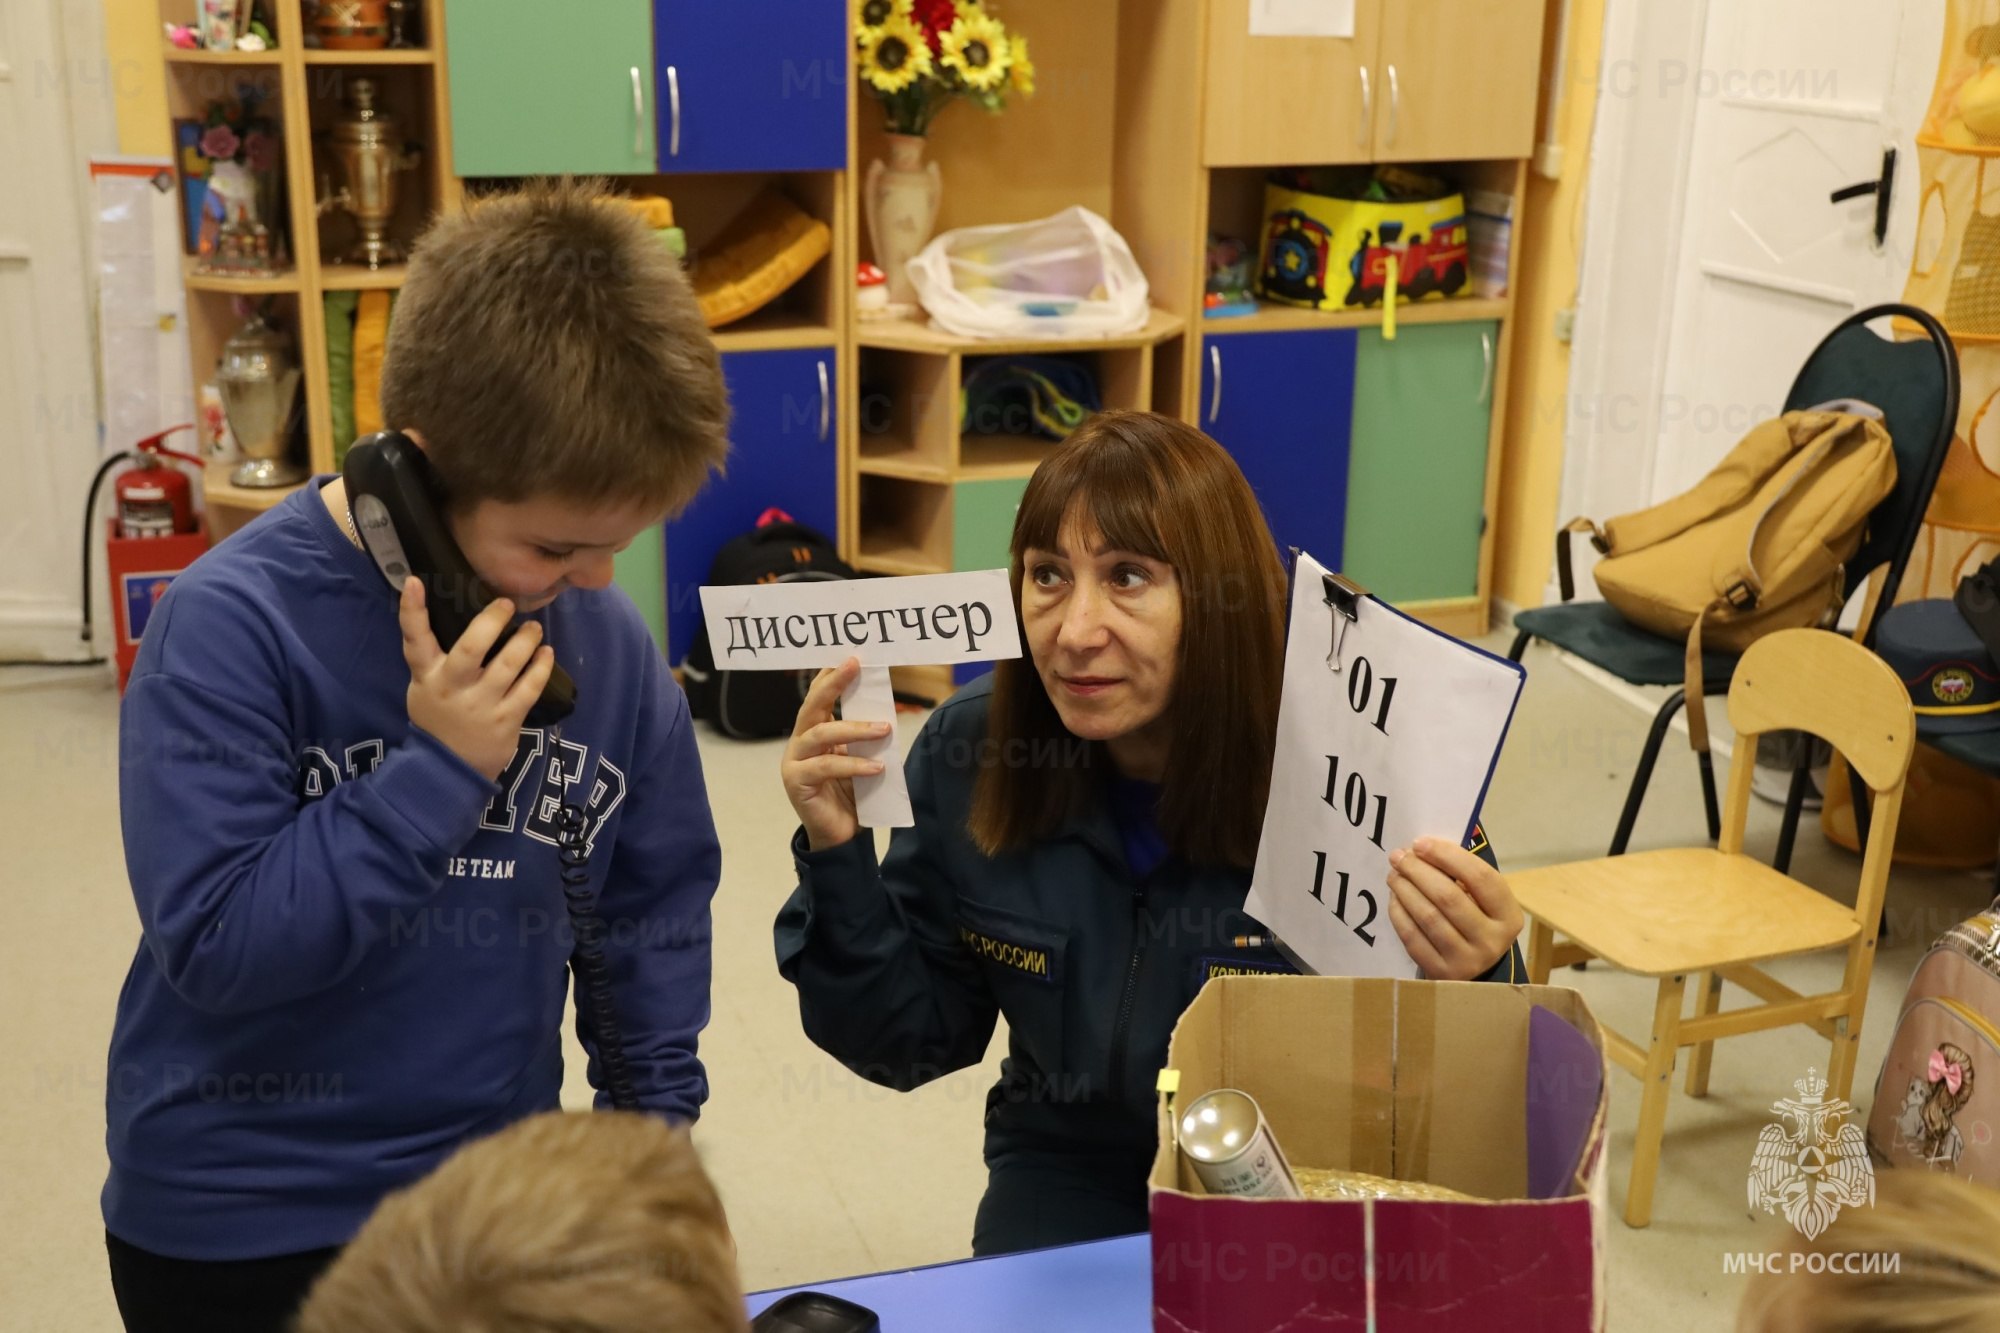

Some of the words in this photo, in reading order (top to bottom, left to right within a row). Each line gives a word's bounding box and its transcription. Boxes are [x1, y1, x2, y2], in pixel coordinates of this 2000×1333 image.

[724, 600, 992, 658] диспетчер
[1348, 656, 1398, 737] 01
[298, 728, 626, 858] PYER
[1320, 755, 1388, 852] 101
[470, 858, 516, 879] TEAM
[1307, 850, 1378, 948] 112
[981, 936, 1046, 975] РОССИИ
